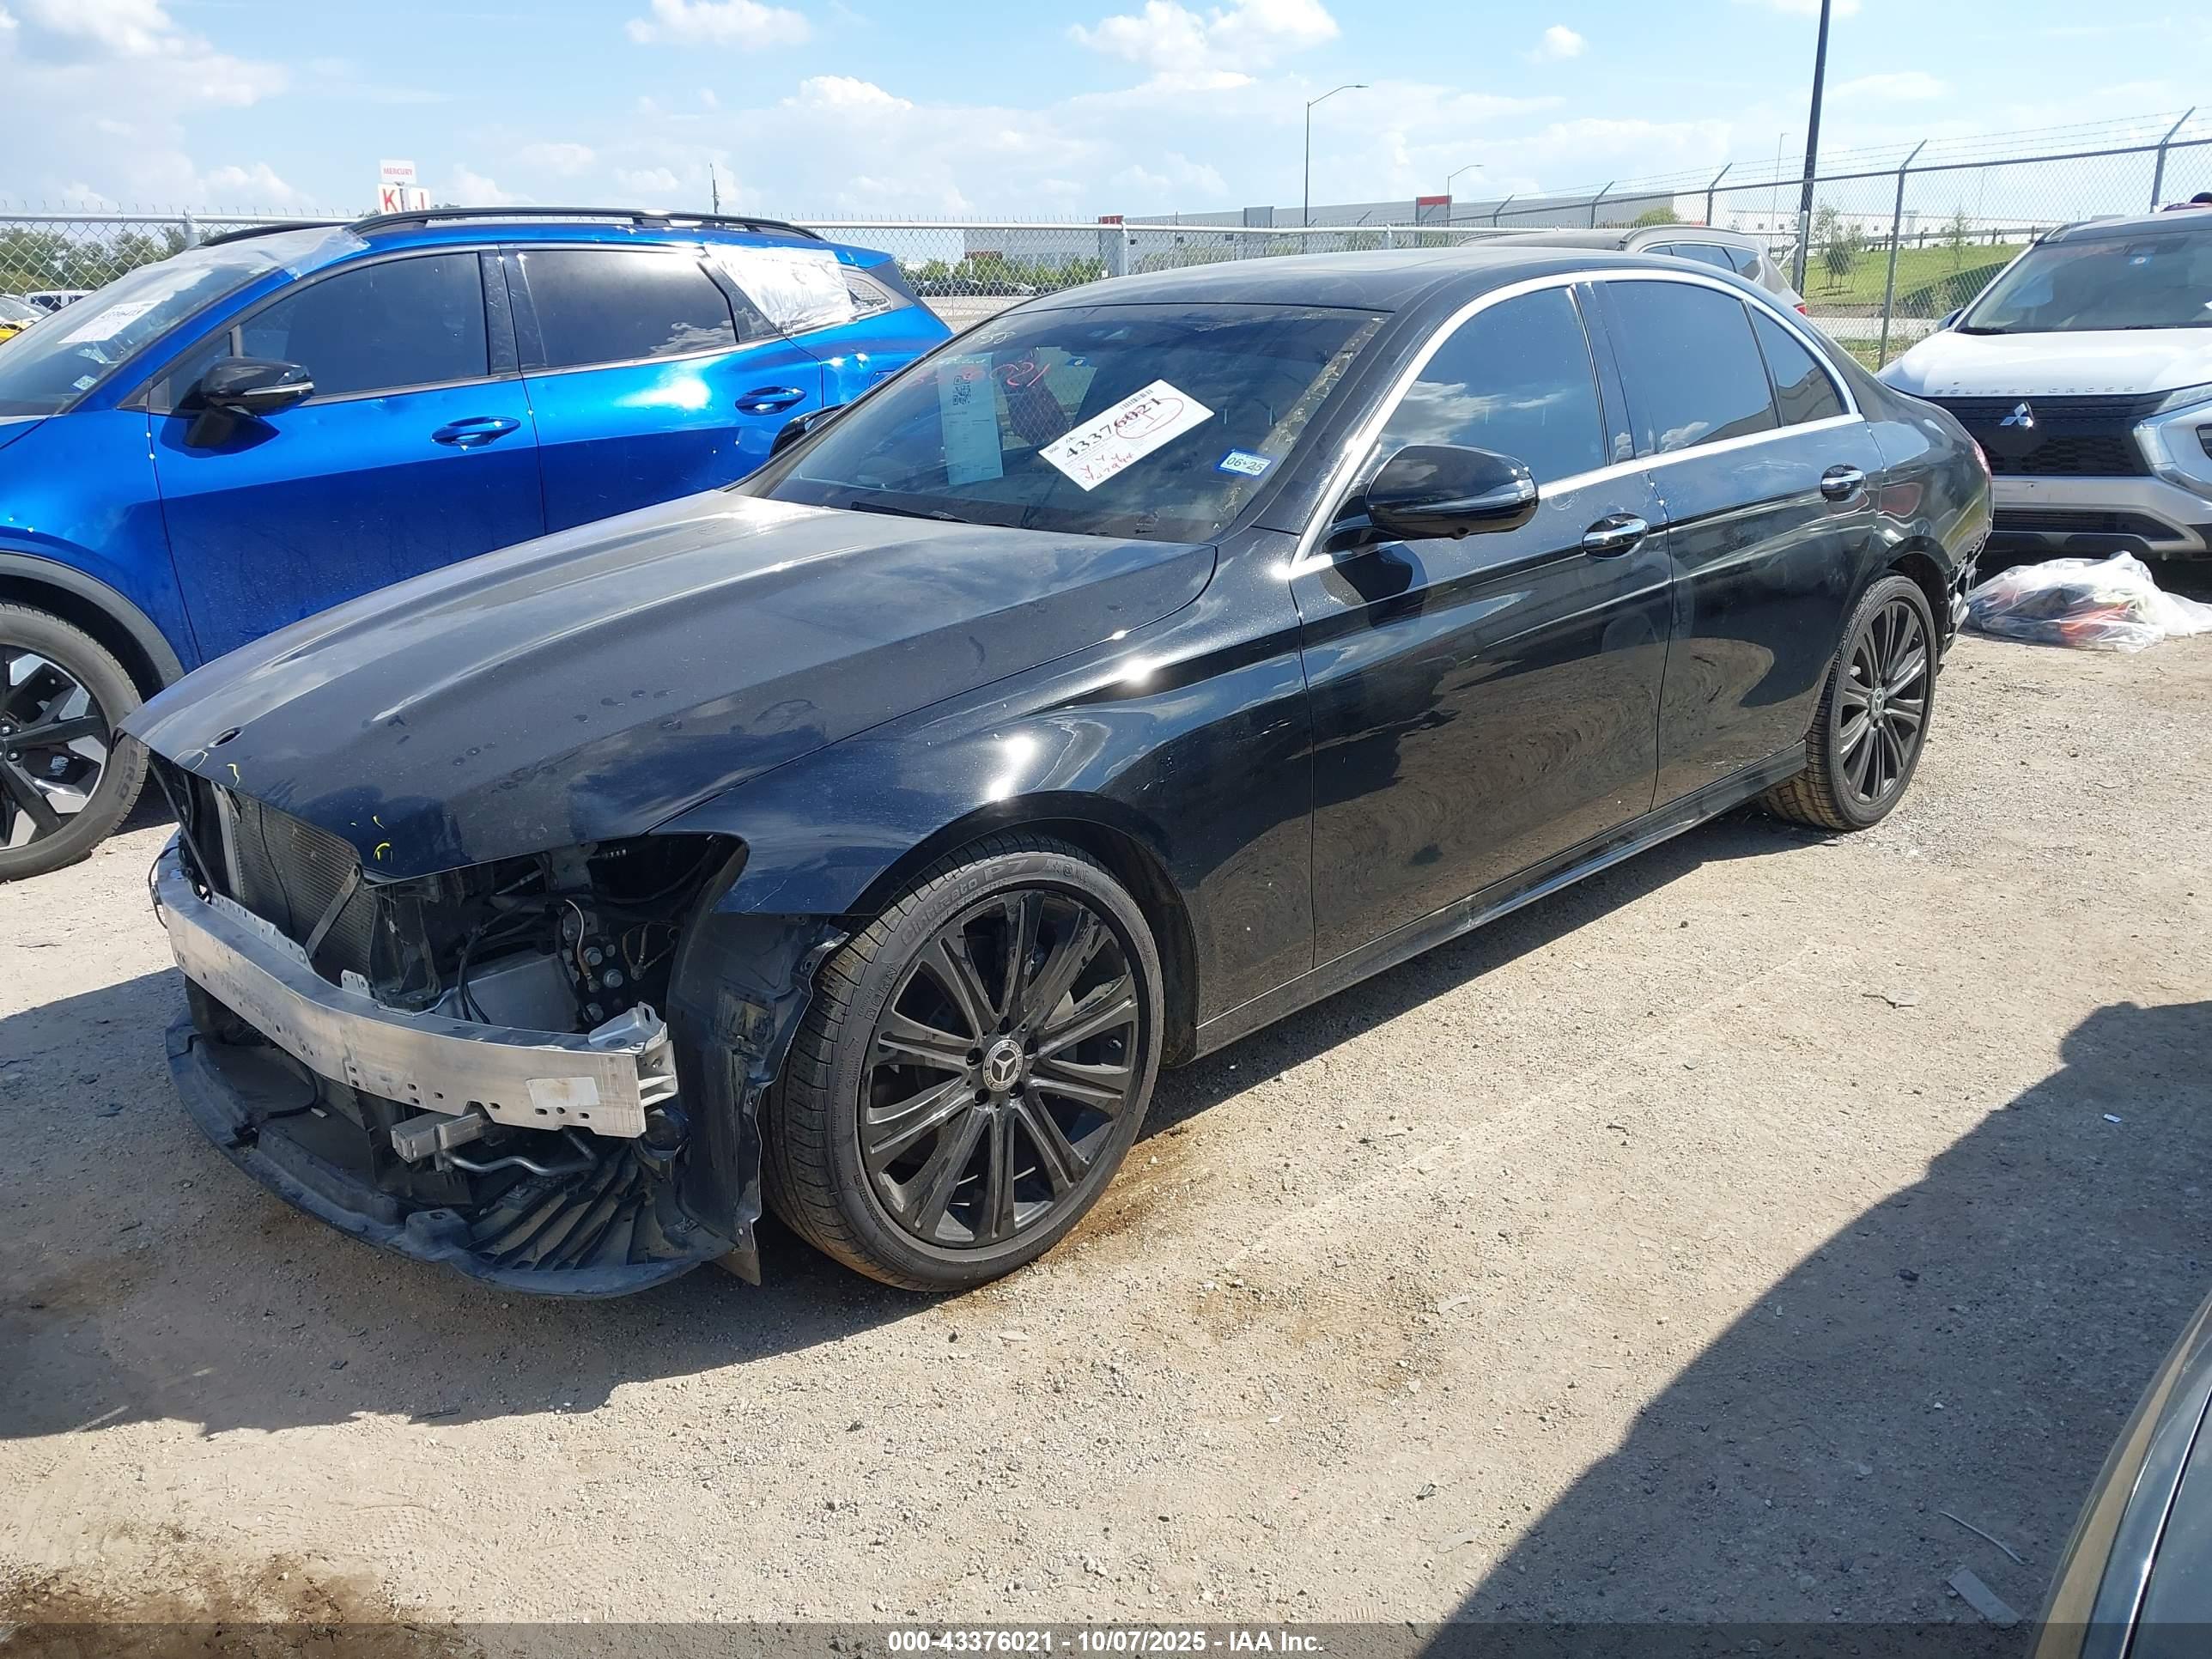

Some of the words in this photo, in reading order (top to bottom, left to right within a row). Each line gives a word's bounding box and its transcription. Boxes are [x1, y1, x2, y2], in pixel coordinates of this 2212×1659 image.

[382, 188, 398, 212] K
[1066, 398, 1162, 458] 43376021
[1226, 457, 1243, 467] 06
[1246, 461, 1265, 471] 25
[902, 877, 978, 945] Cinturato
[982, 859, 1030, 882] P7
